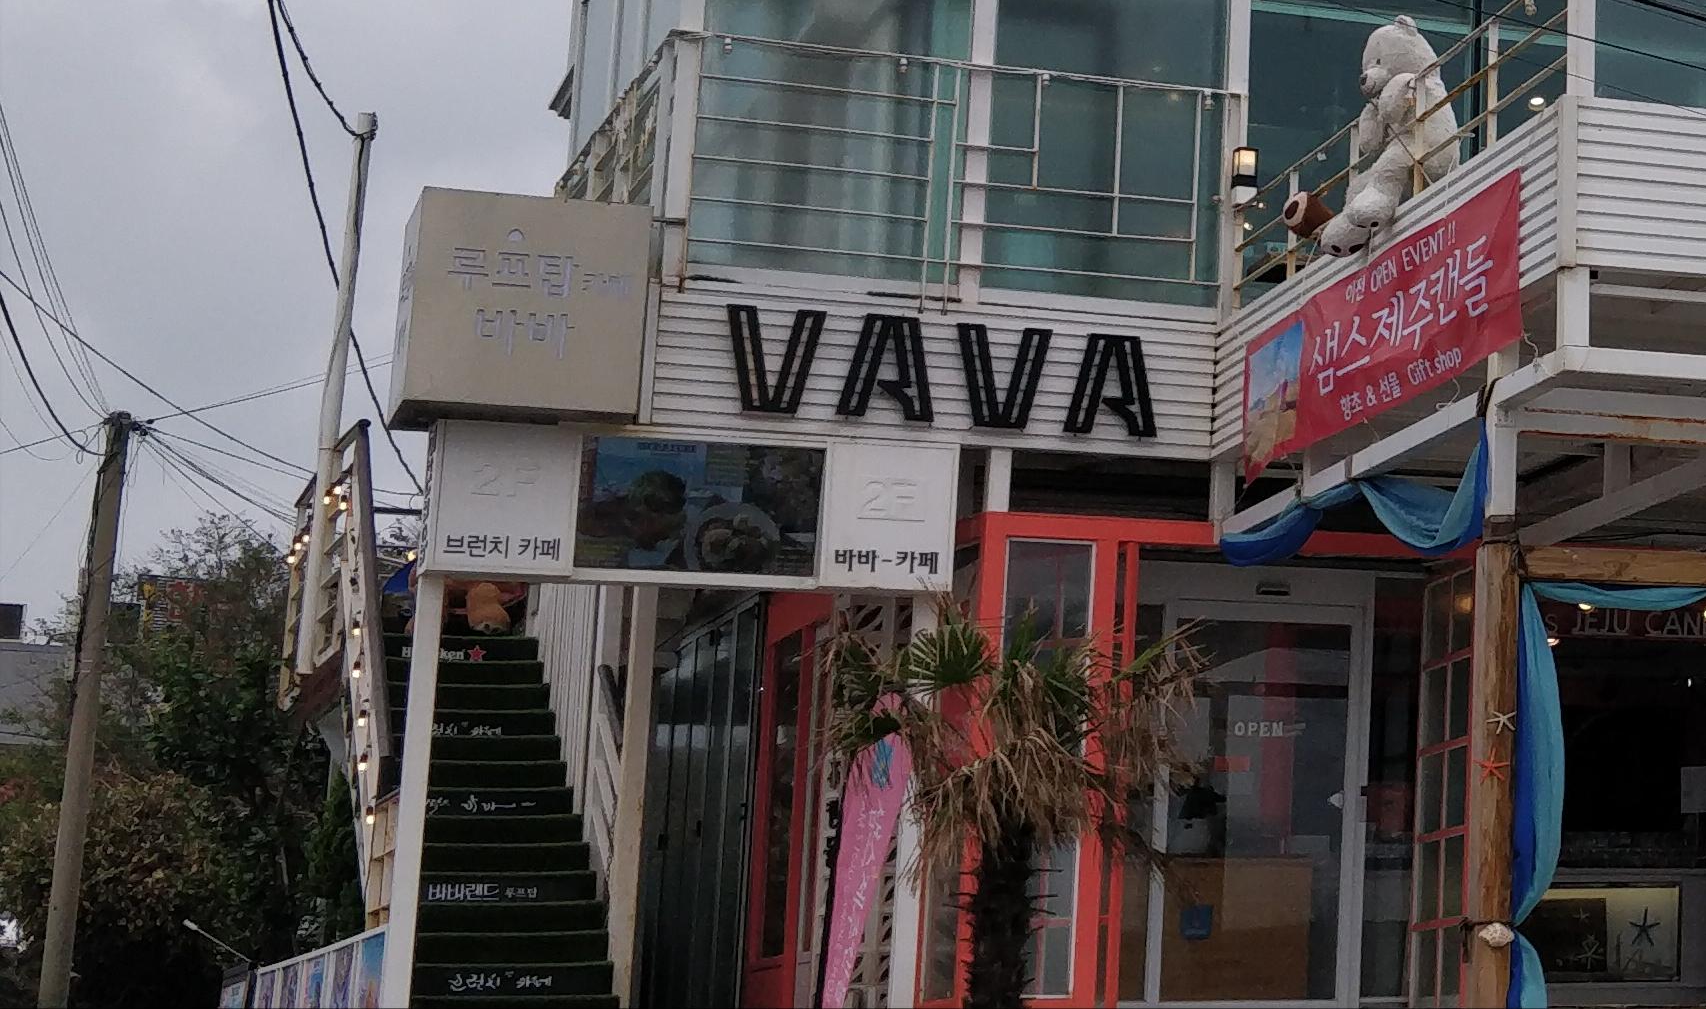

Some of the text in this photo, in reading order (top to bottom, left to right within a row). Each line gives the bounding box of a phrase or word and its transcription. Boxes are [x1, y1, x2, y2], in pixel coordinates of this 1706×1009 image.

[448, 247, 580, 298] 루프탑
[1346, 275, 1366, 303] 이전
[1371, 256, 1398, 292] OPEN
[1402, 227, 1445, 271] EVENT
[475, 308, 576, 360] 바바
[1308, 235, 1494, 395] 샘스제주캔들
[726, 303, 1157, 438] VAVA
[1366, 385, 1377, 406] &
[1379, 372, 1402, 403] 선물
[1407, 358, 1433, 385] Gift
[1434, 347, 1461, 374] shop
[443, 534, 510, 559] 브런치
[517, 536, 561, 561] 카페
[1234, 721, 1284, 737] OPEN
